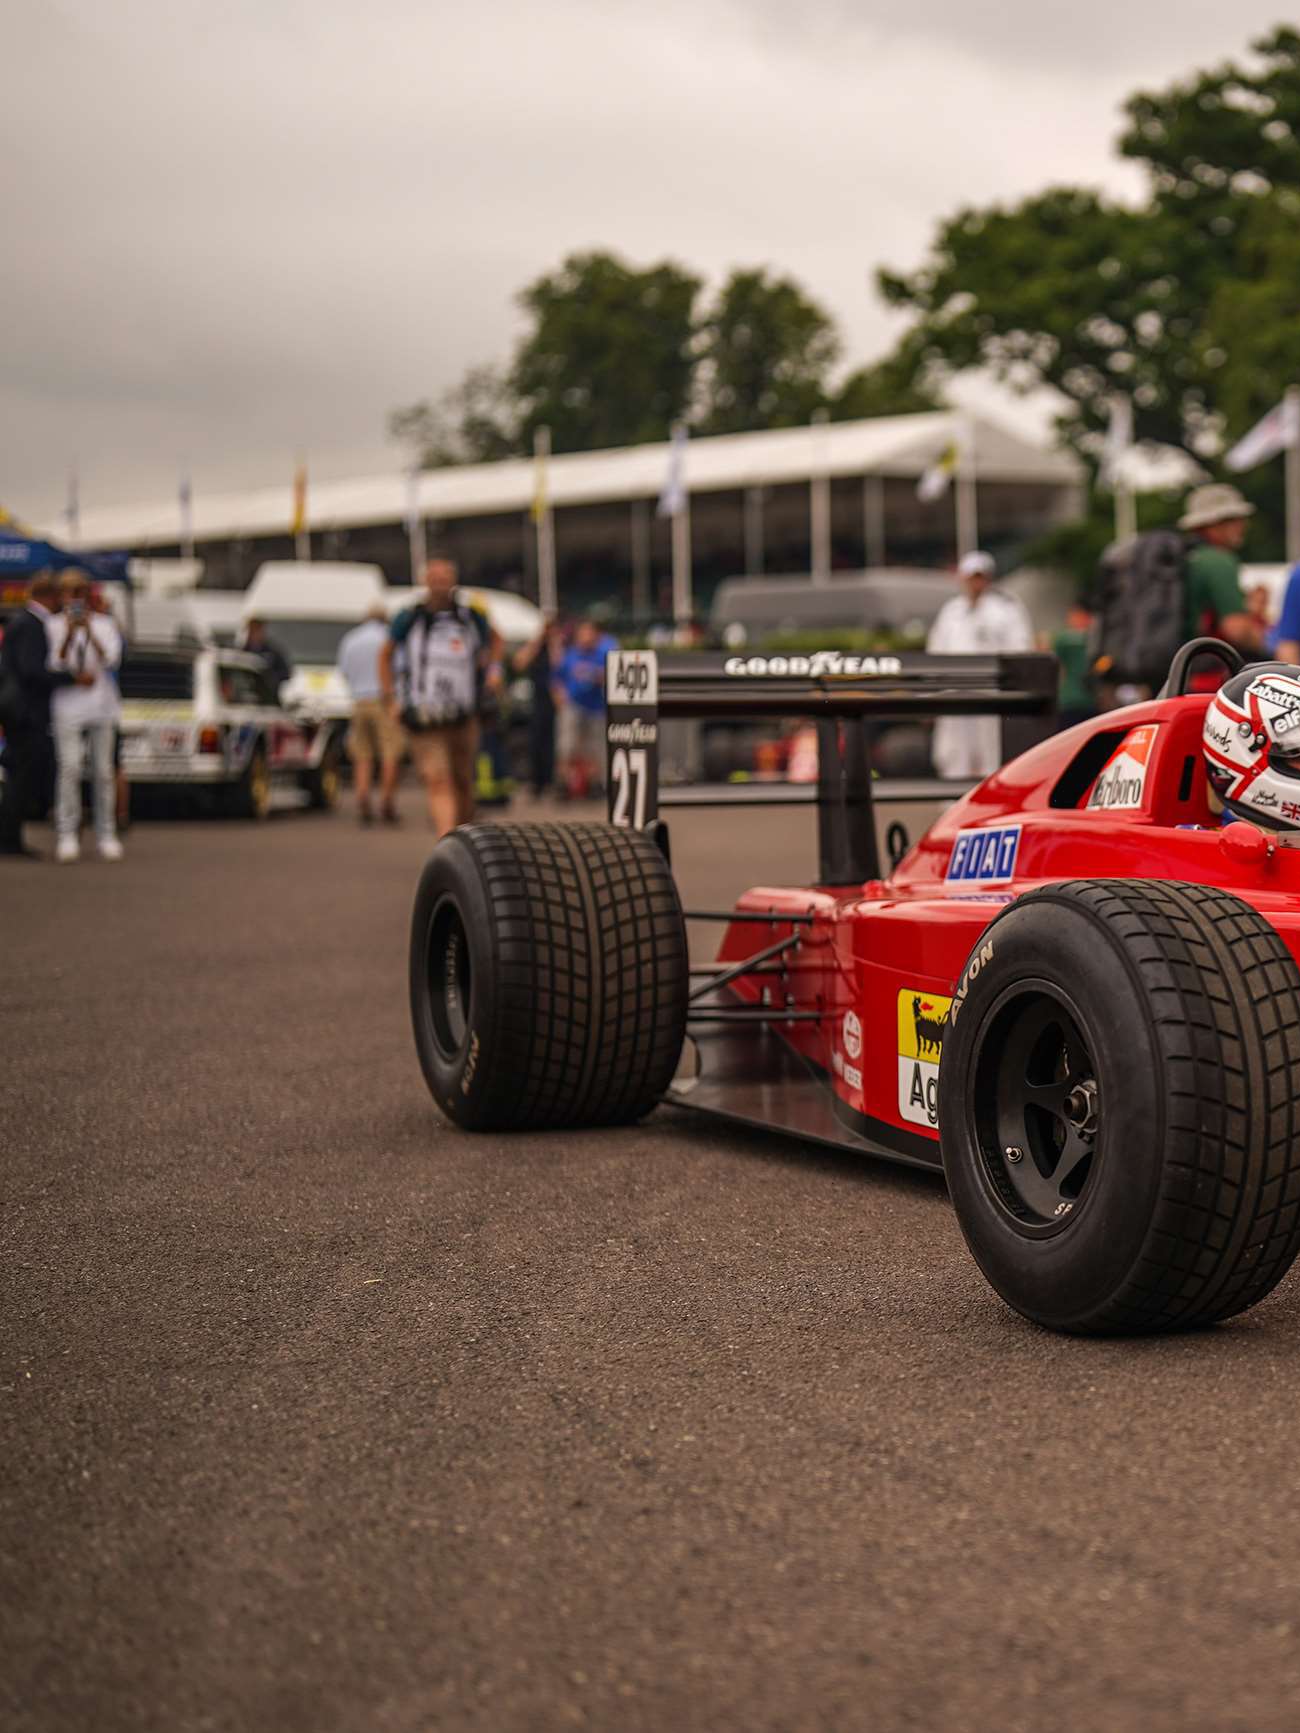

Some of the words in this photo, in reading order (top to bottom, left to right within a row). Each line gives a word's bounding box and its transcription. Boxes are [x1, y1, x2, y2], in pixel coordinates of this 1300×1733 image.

[616, 652, 648, 703] Agip
[724, 651, 902, 678] GOODYEAR
[612, 748, 647, 832] 27
[952, 836, 1016, 874] FIAT
[951, 940, 995, 1028] AVON
[909, 1062, 939, 1125] Ag
